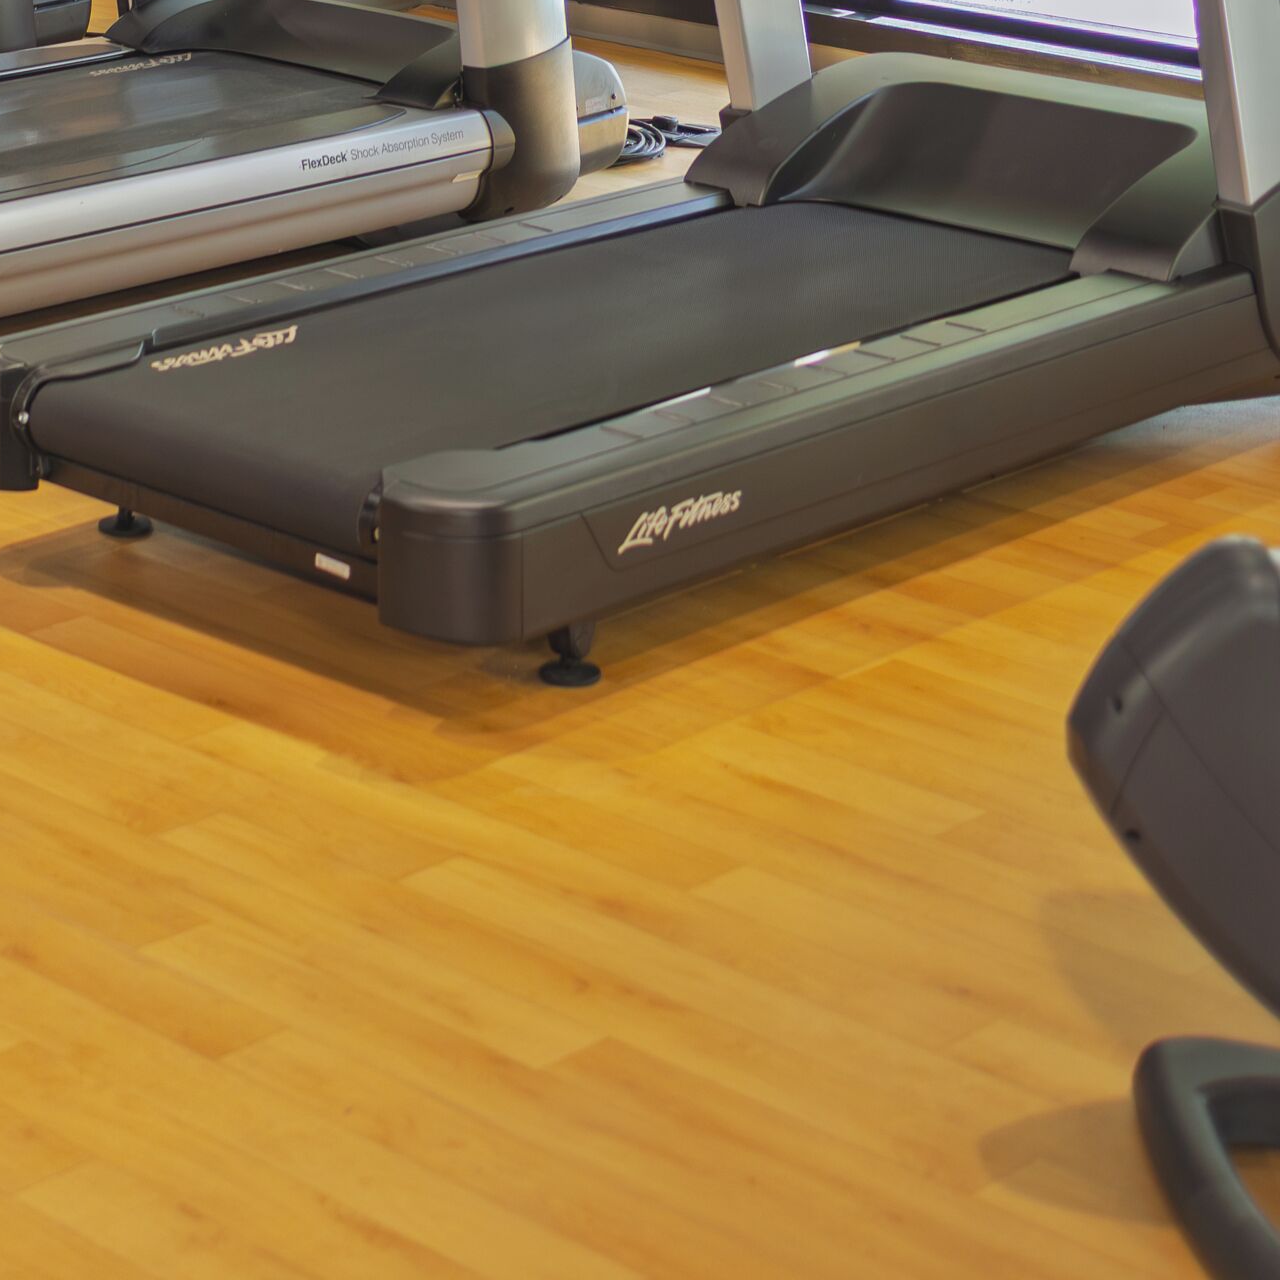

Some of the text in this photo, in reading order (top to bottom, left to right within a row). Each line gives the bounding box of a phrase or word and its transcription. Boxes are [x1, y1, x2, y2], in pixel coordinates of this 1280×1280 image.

[301, 128, 464, 171] FlexDeck Shock Absorption System
[617, 490, 742, 555] Life Fitness
